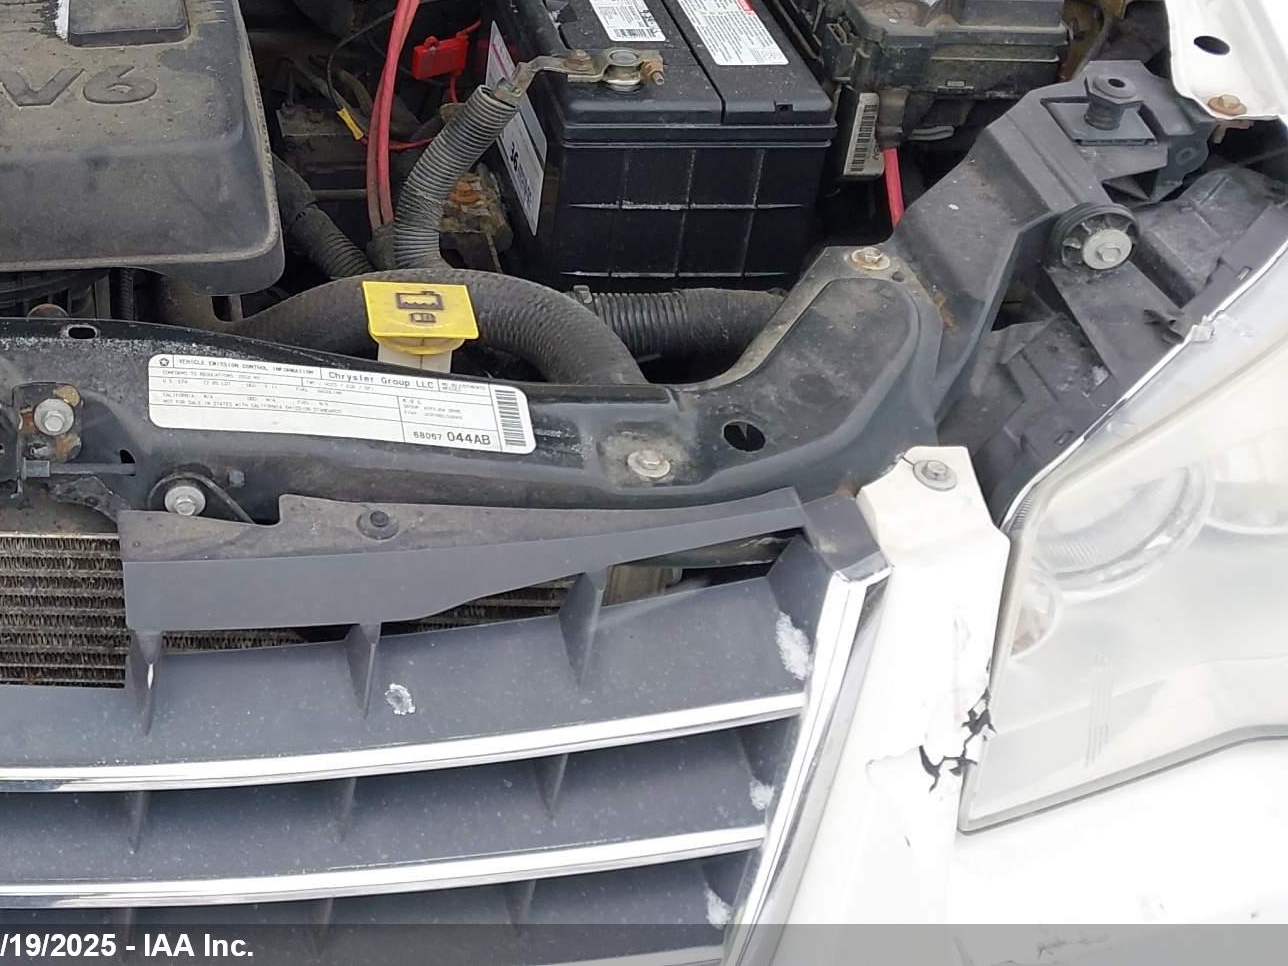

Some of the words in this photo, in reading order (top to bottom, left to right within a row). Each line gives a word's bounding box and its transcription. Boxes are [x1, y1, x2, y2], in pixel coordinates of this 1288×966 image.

[328, 371, 374, 385] Chrysler
[381, 377, 411, 388] Group
[416, 380, 434, 389] LLC
[447, 431, 491, 445] 044AB
